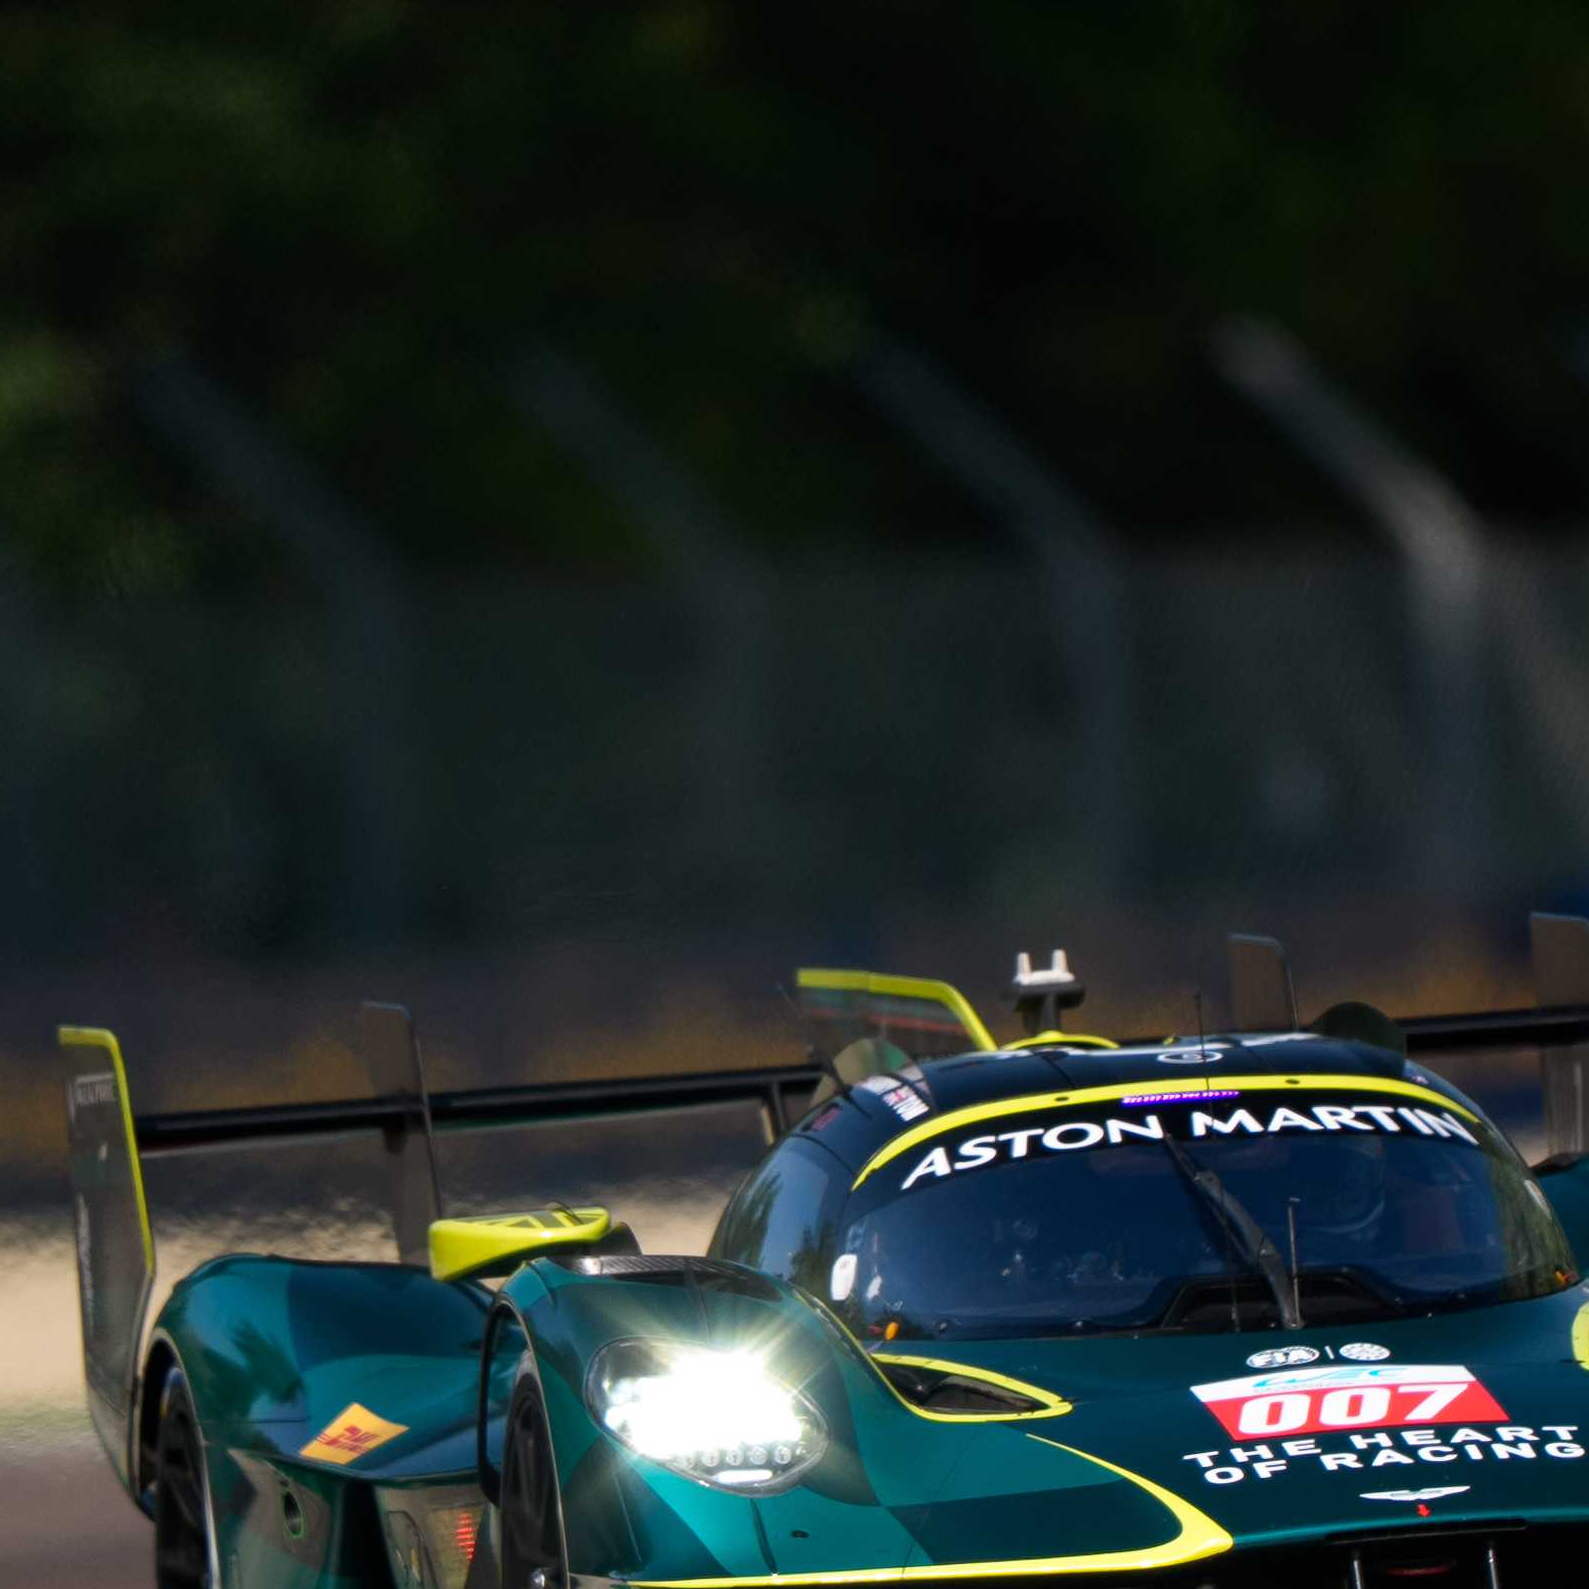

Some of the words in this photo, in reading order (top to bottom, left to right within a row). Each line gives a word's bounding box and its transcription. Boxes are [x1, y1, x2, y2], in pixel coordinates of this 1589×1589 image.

[900, 1114, 1164, 1190] ASTON
[1191, 1105, 1480, 1146] MARTIN
[1238, 1383, 1469, 1435] 007
[1182, 1439, 1322, 1469] THE
[1349, 1425, 1579, 1450] HEART
[1204, 1459, 1289, 1485] OF
[1320, 1441, 1586, 1471] RACING
